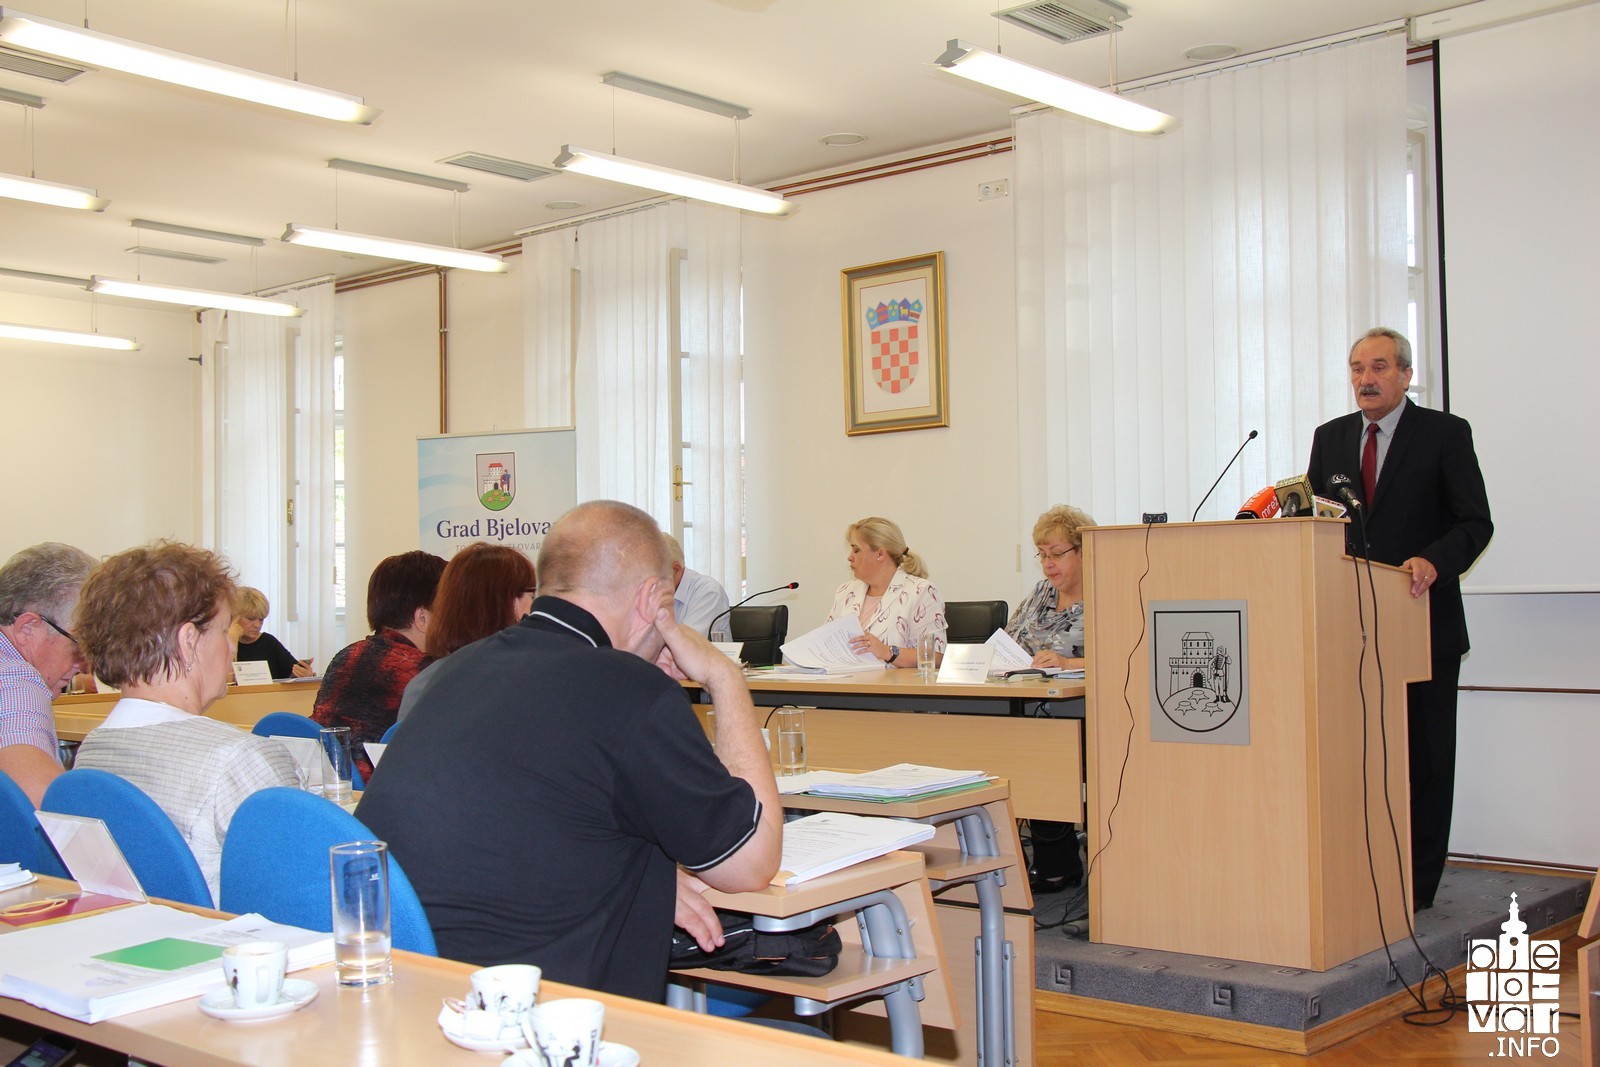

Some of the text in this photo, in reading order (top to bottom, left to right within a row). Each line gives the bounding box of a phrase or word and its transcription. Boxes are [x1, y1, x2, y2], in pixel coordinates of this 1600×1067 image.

[1261, 495, 1280, 519] mrež
[436, 518, 553, 541] Grad Bjelova
